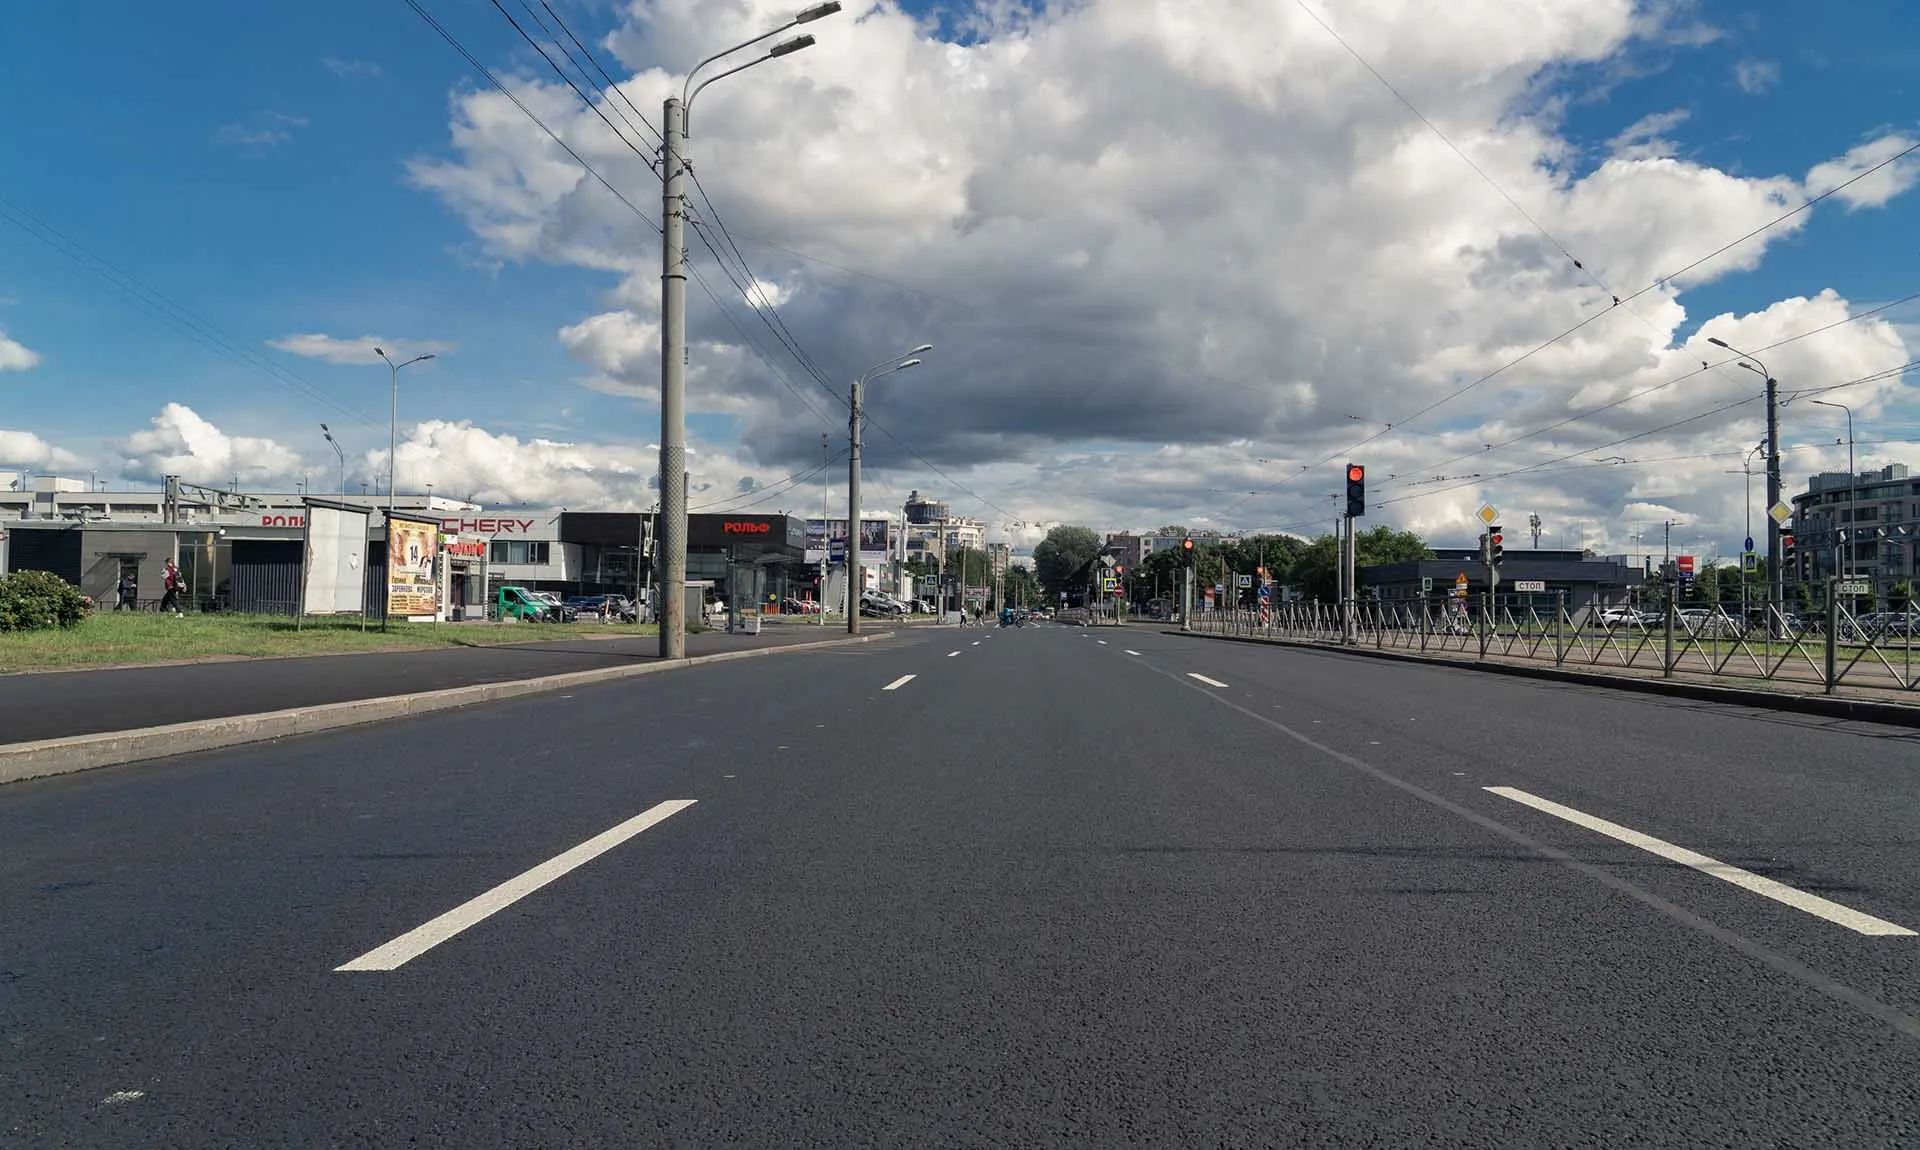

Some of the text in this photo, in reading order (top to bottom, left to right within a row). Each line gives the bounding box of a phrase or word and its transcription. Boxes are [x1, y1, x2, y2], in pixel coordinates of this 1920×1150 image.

[441, 518, 535, 533] CHERY
[723, 522, 769, 534] РОЛЬФ
[410, 545, 419, 561] 14
[1519, 582, 1541, 590] СТОП
[1841, 585, 1865, 593] СТОП
